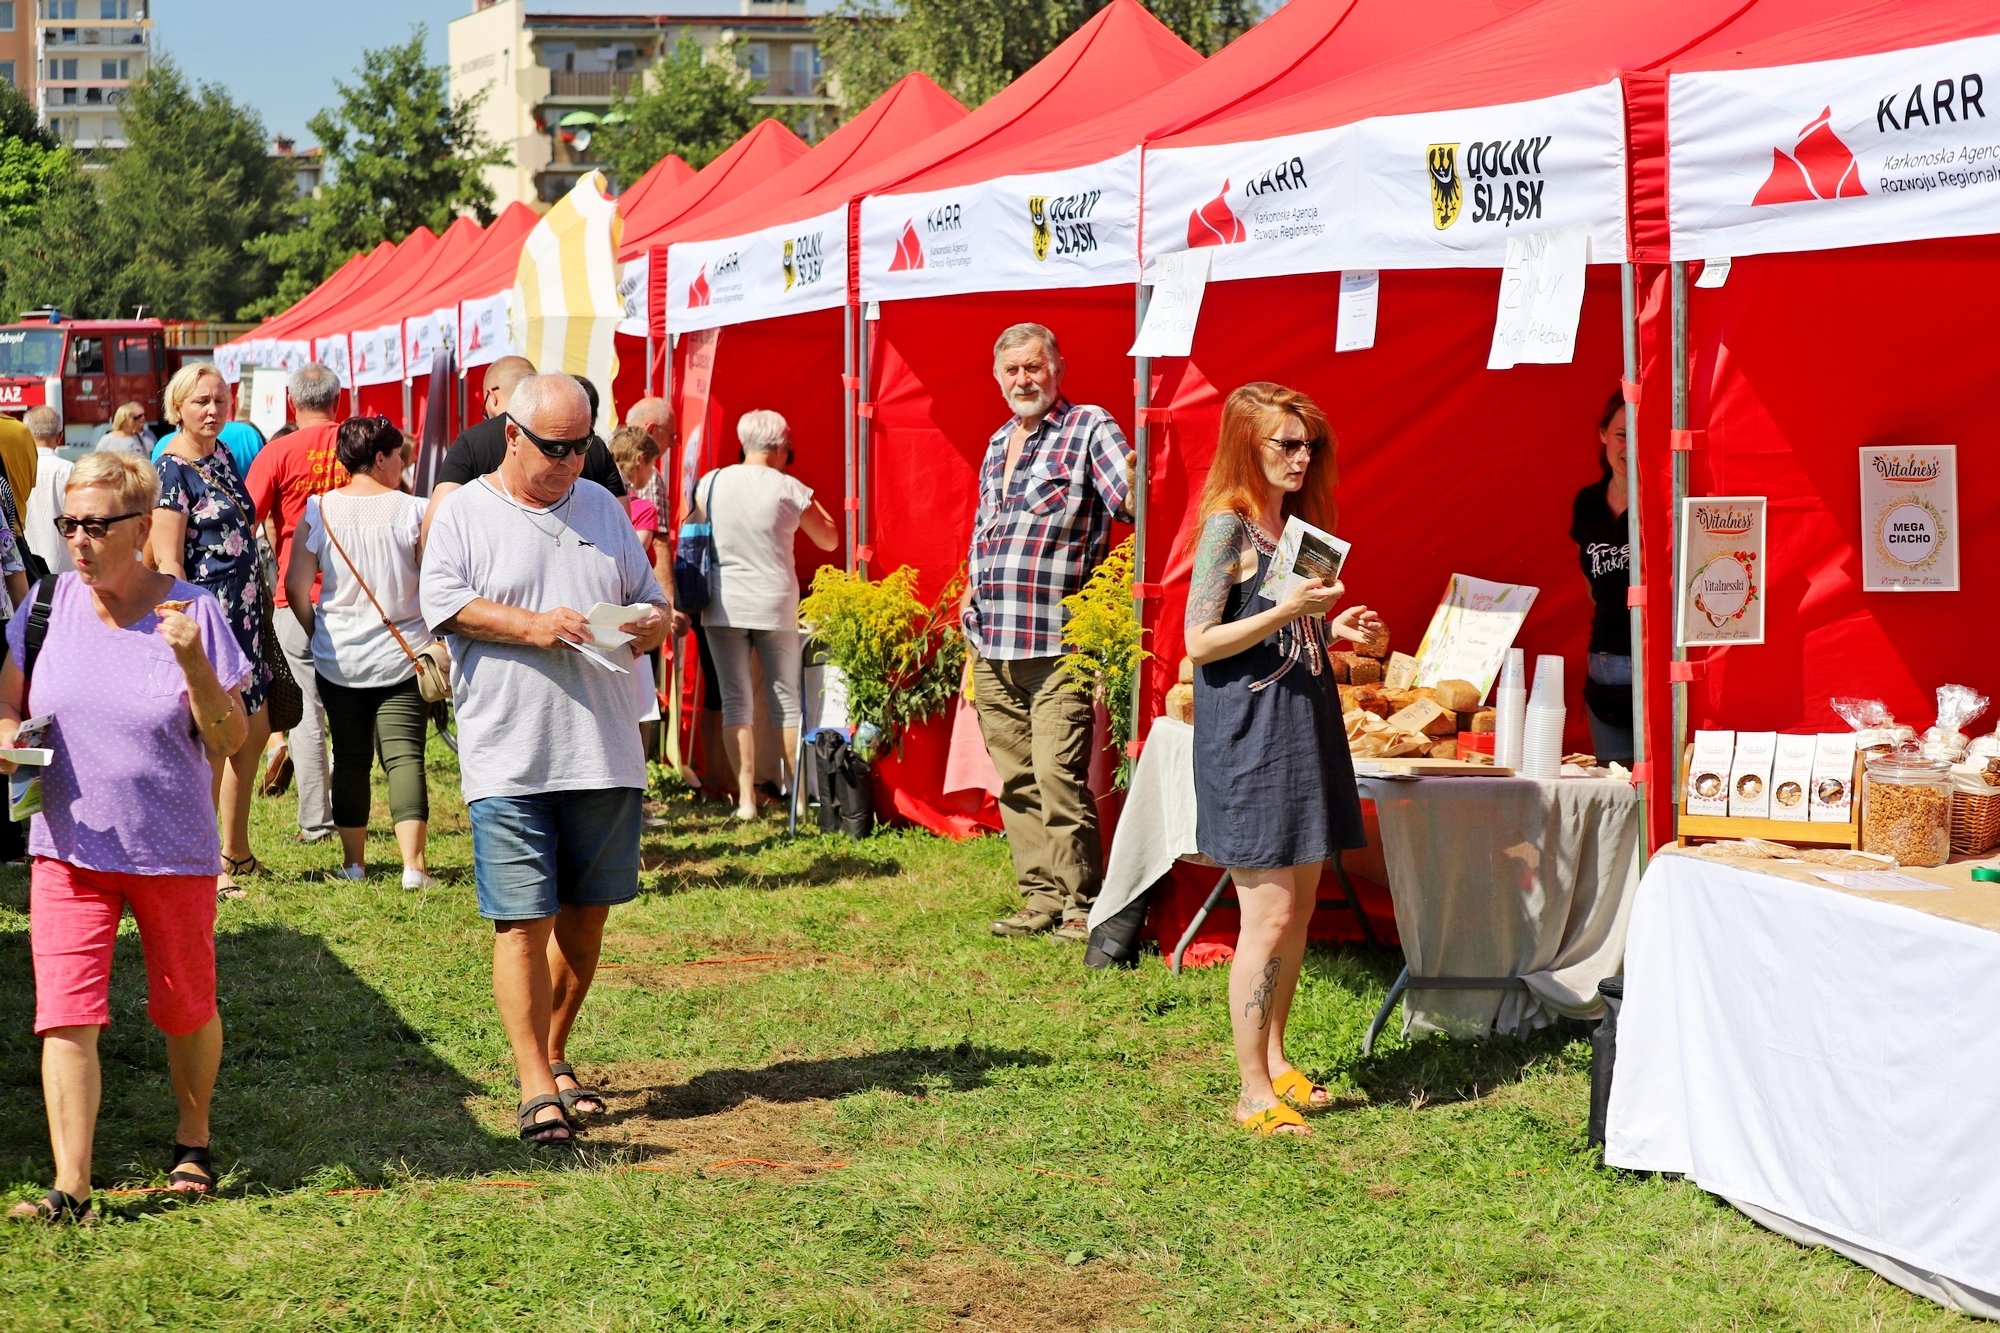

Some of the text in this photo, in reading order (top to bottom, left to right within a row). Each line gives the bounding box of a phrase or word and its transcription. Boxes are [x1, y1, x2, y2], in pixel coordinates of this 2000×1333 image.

[1876, 73, 1986, 133] KARR
[1467, 136, 1552, 178] DOLNY
[1883, 145, 2000, 171] Karkonoska Agenc
[1880, 164, 2000, 194] Rozwoju Regional
[1472, 175, 1544, 228] ŚLĄSK
[927, 203, 962, 233] KARR
[1056, 219, 1097, 257] ŚLĄSK
[1876, 459, 1938, 478] Vitalness
[1699, 511, 1752, 530] Vitalness
[1893, 523, 1925, 532] MEGA
[1888, 534, 1931, 544] CIACHO
[1704, 579, 1744, 592] Vitalnesski
